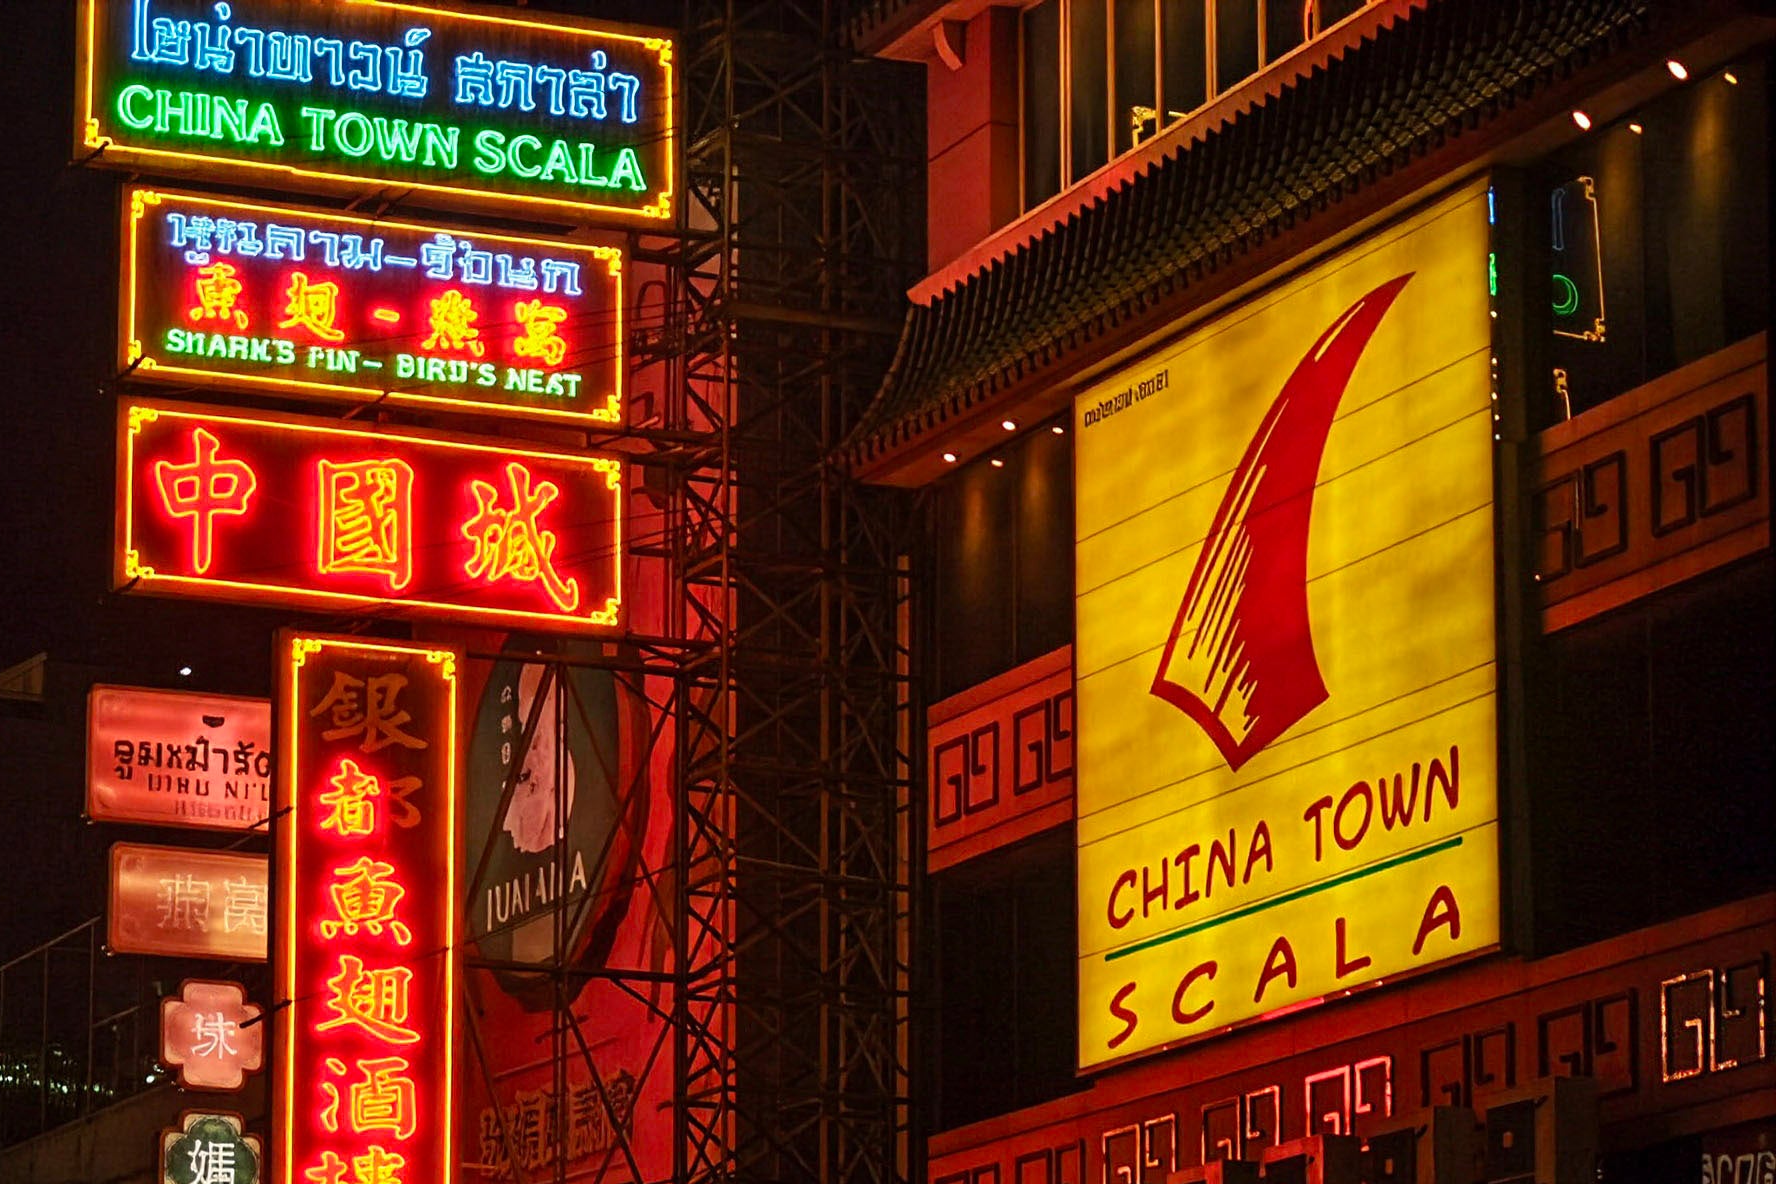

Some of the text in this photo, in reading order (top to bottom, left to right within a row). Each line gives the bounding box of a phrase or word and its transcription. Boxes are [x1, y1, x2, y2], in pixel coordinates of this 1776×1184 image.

[118, 84, 647, 191] CHINA TOWN SCALA
[455, 51, 640, 123] สกาล่า
[165, 328, 296, 365] SHARK'S
[396, 353, 497, 387] BIRD'S
[505, 367, 582, 398] NEST
[155, 428, 578, 611] 中國城
[1107, 745, 1459, 929] CHINA TOWN
[1107, 886, 1461, 1049] SCALA
